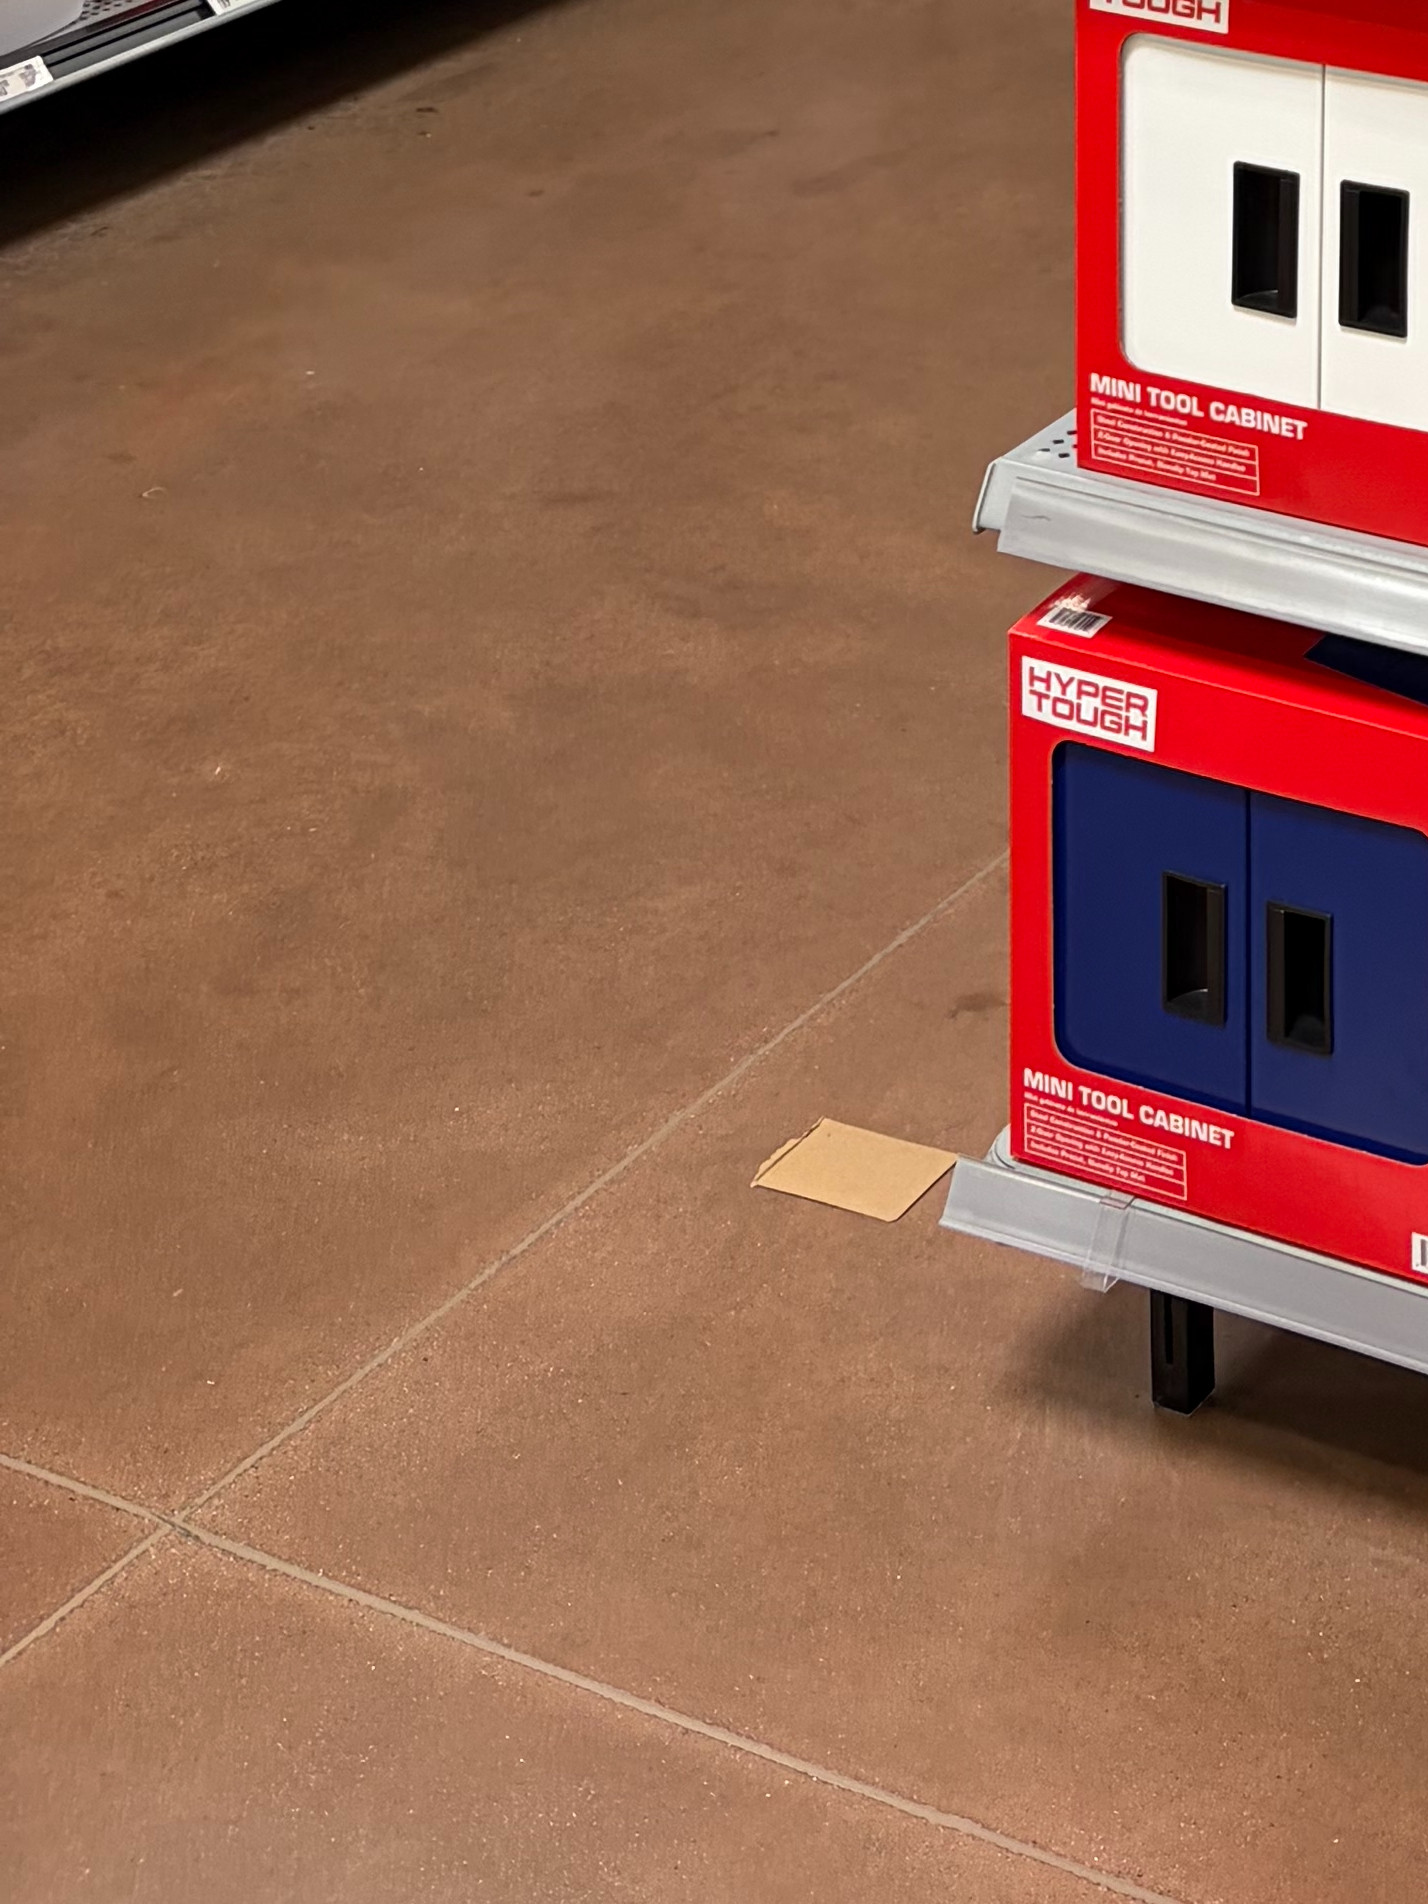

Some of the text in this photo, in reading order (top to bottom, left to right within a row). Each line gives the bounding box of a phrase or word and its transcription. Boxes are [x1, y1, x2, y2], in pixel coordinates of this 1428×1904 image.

[1090, 372, 1307, 440] MINI TOOL CABINET
[1028, 665, 1150, 720] HYPER
[1029, 688, 1149, 742] TOUGH
[1024, 1067, 1234, 1149] MINI TOOL CABINET
